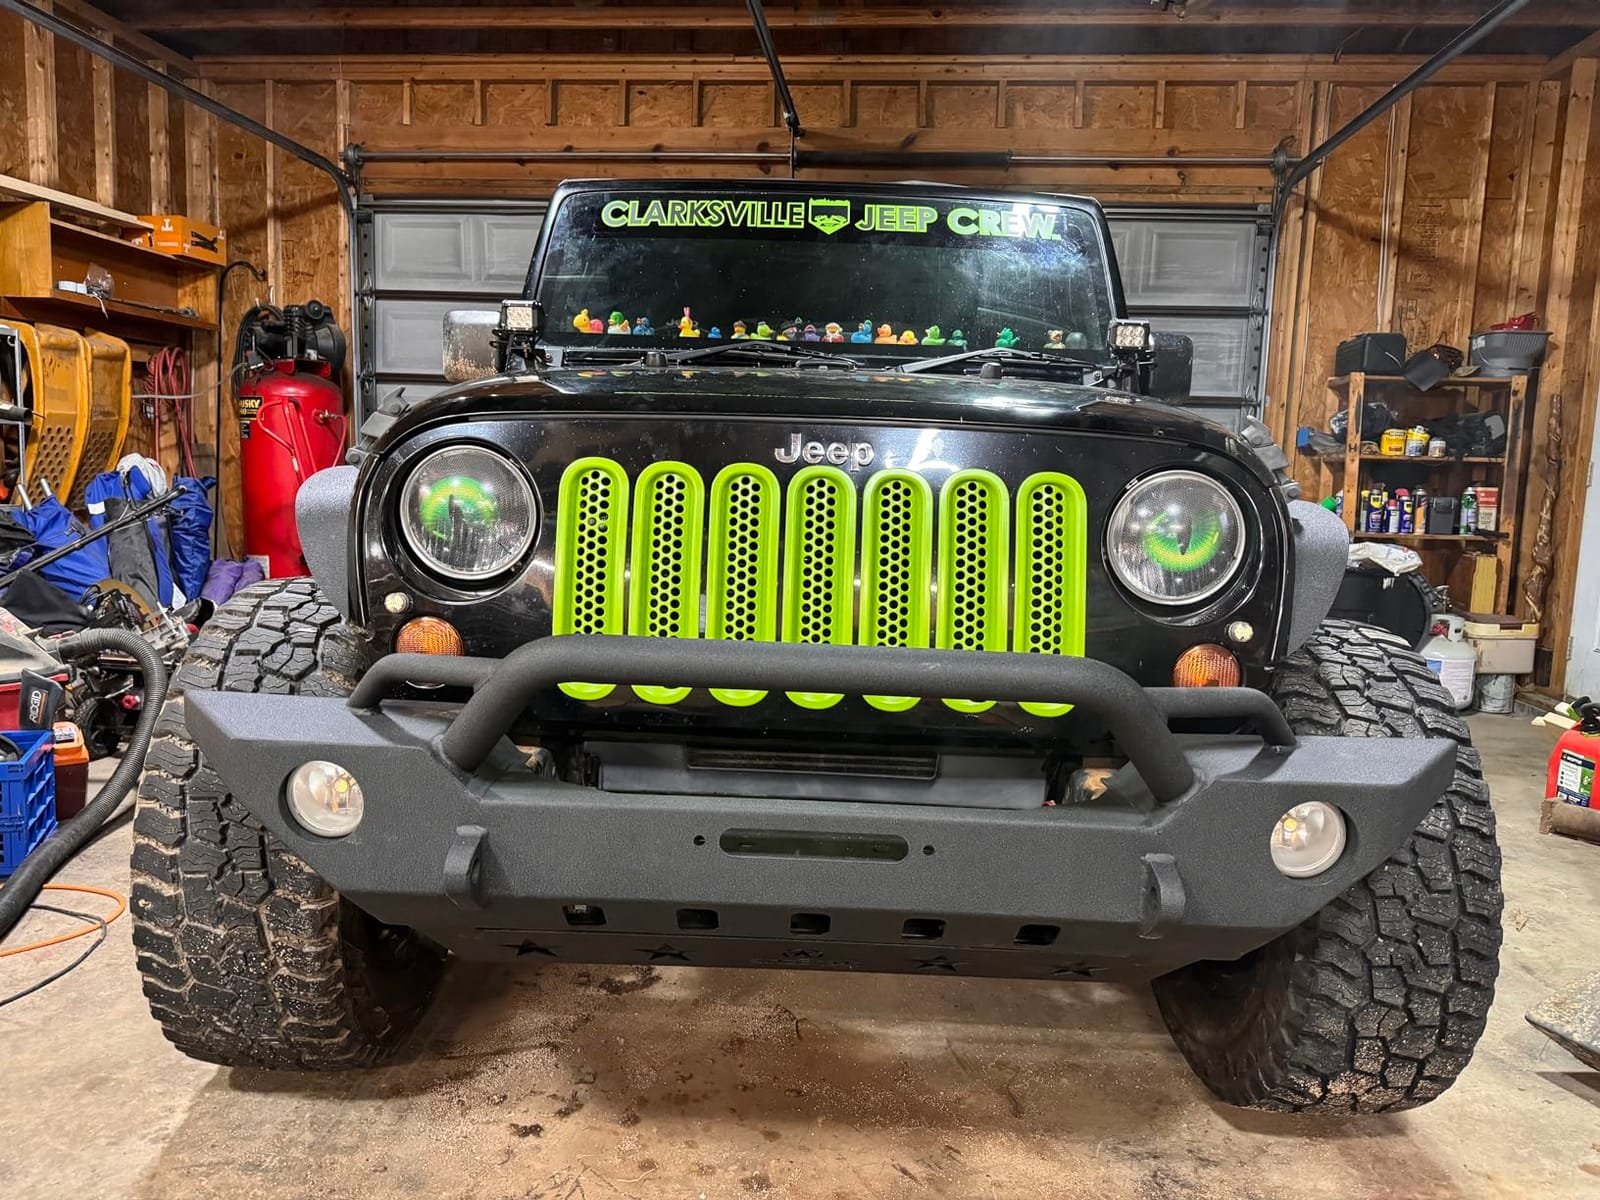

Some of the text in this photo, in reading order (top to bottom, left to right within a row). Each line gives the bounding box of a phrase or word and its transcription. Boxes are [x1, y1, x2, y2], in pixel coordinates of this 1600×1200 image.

[601, 200, 1056, 239] CLARKSVILLE JEEP CREW
[239, 399, 261, 409] USKY
[774, 432, 875, 472] Jeep
